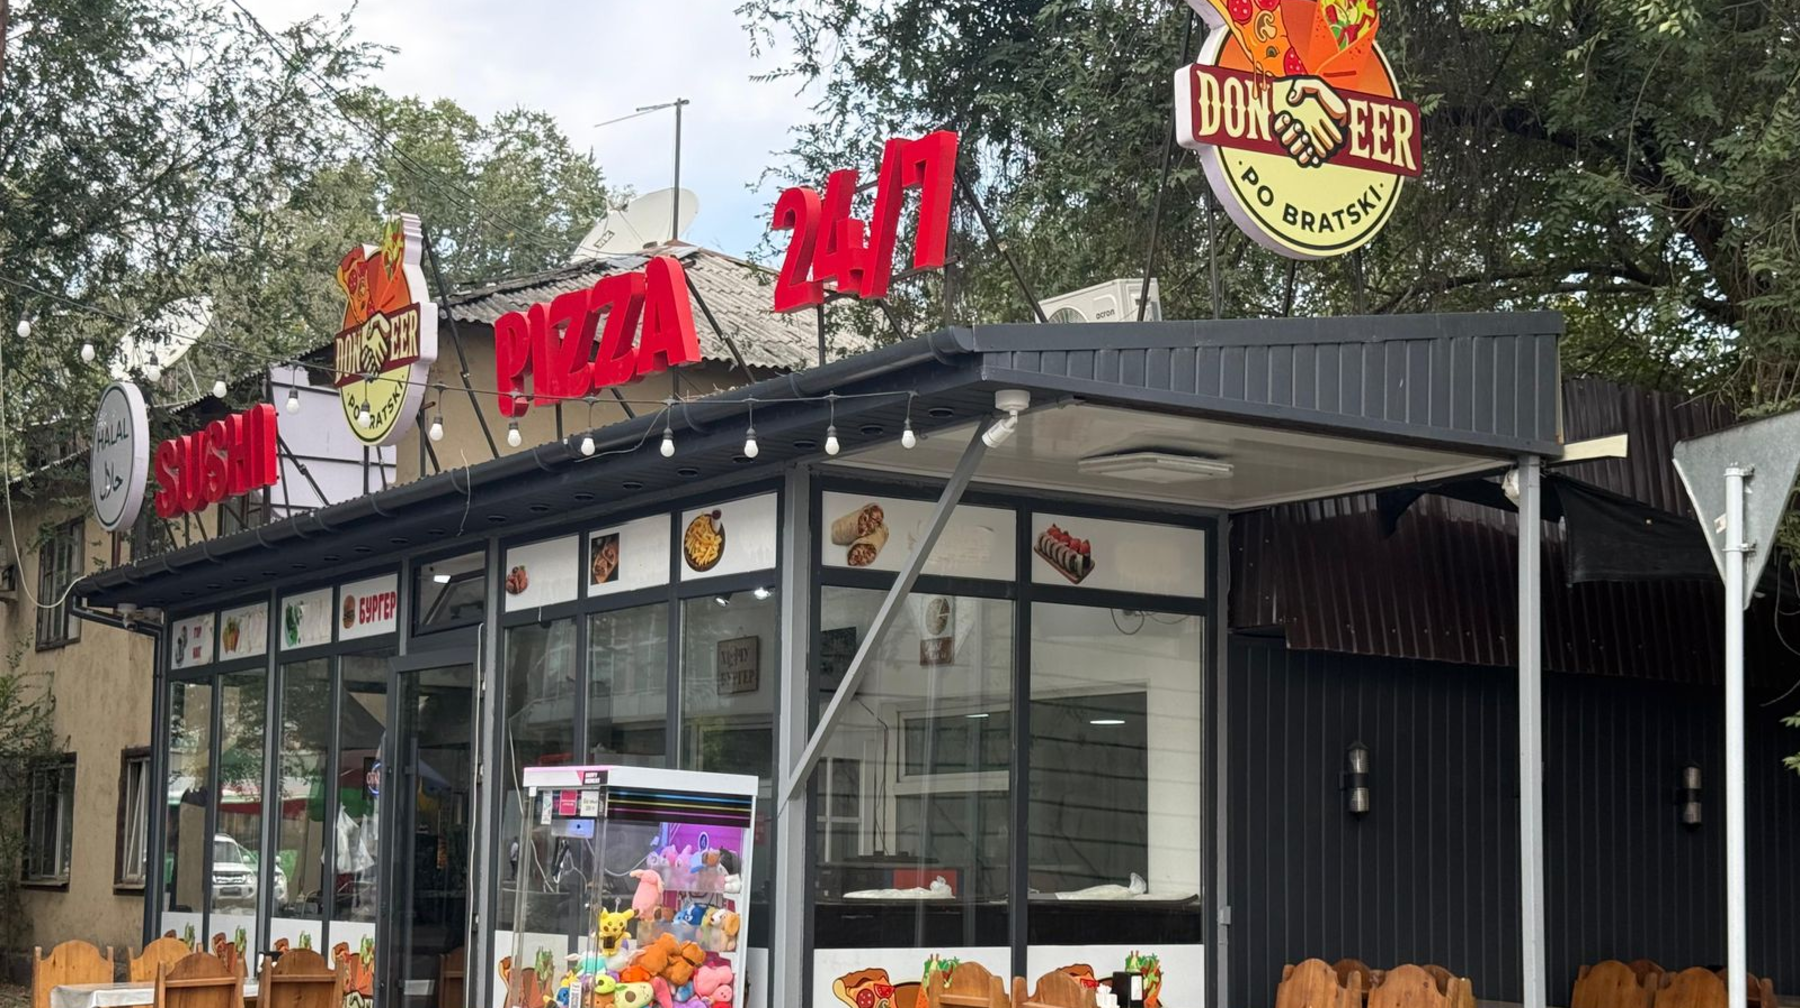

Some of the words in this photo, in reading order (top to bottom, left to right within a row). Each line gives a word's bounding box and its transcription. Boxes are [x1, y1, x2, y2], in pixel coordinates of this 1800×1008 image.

[1196, 70, 1273, 142] DON
[1346, 97, 1417, 171] EER
[772, 130, 959, 313] 24/7
[1240, 165, 1275, 208] PO
[1282, 187, 1383, 234] BRATSKI
[334, 332, 362, 385] DON
[389, 307, 419, 361] EER
[494, 255, 702, 418] PIZZA
[97, 417, 129, 453] HALAL
[366, 380, 405, 430] RATSKI
[99, 460, 124, 502] حلال
[155, 403, 278, 519] SUSHI
[358, 591, 397, 624] БУРГЕР
